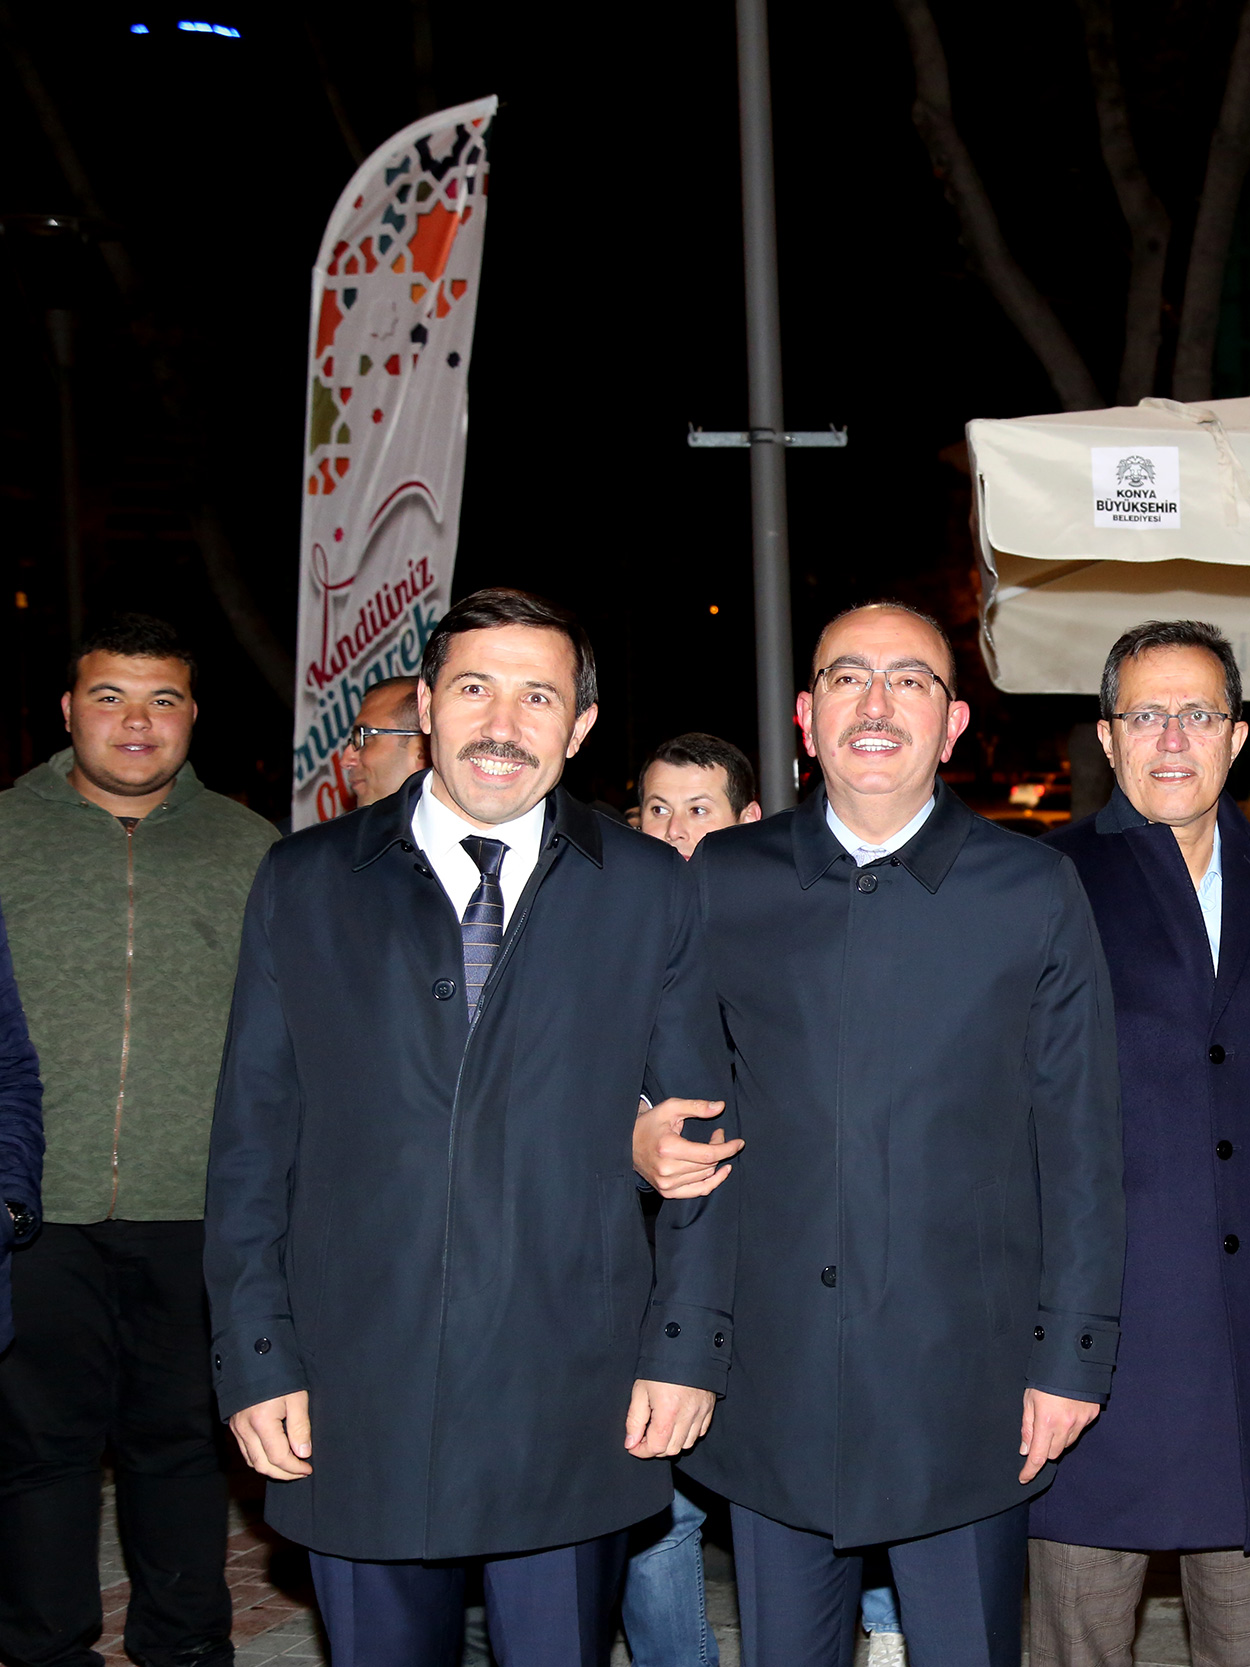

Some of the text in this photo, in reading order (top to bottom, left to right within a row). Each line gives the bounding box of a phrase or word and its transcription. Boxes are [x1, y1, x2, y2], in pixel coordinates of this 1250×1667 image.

[1117, 489, 1157, 499] KONYA
[1096, 498, 1177, 514] BÜYÜKŞEHİR
[1113, 514, 1161, 522] BELEDİYESİ
